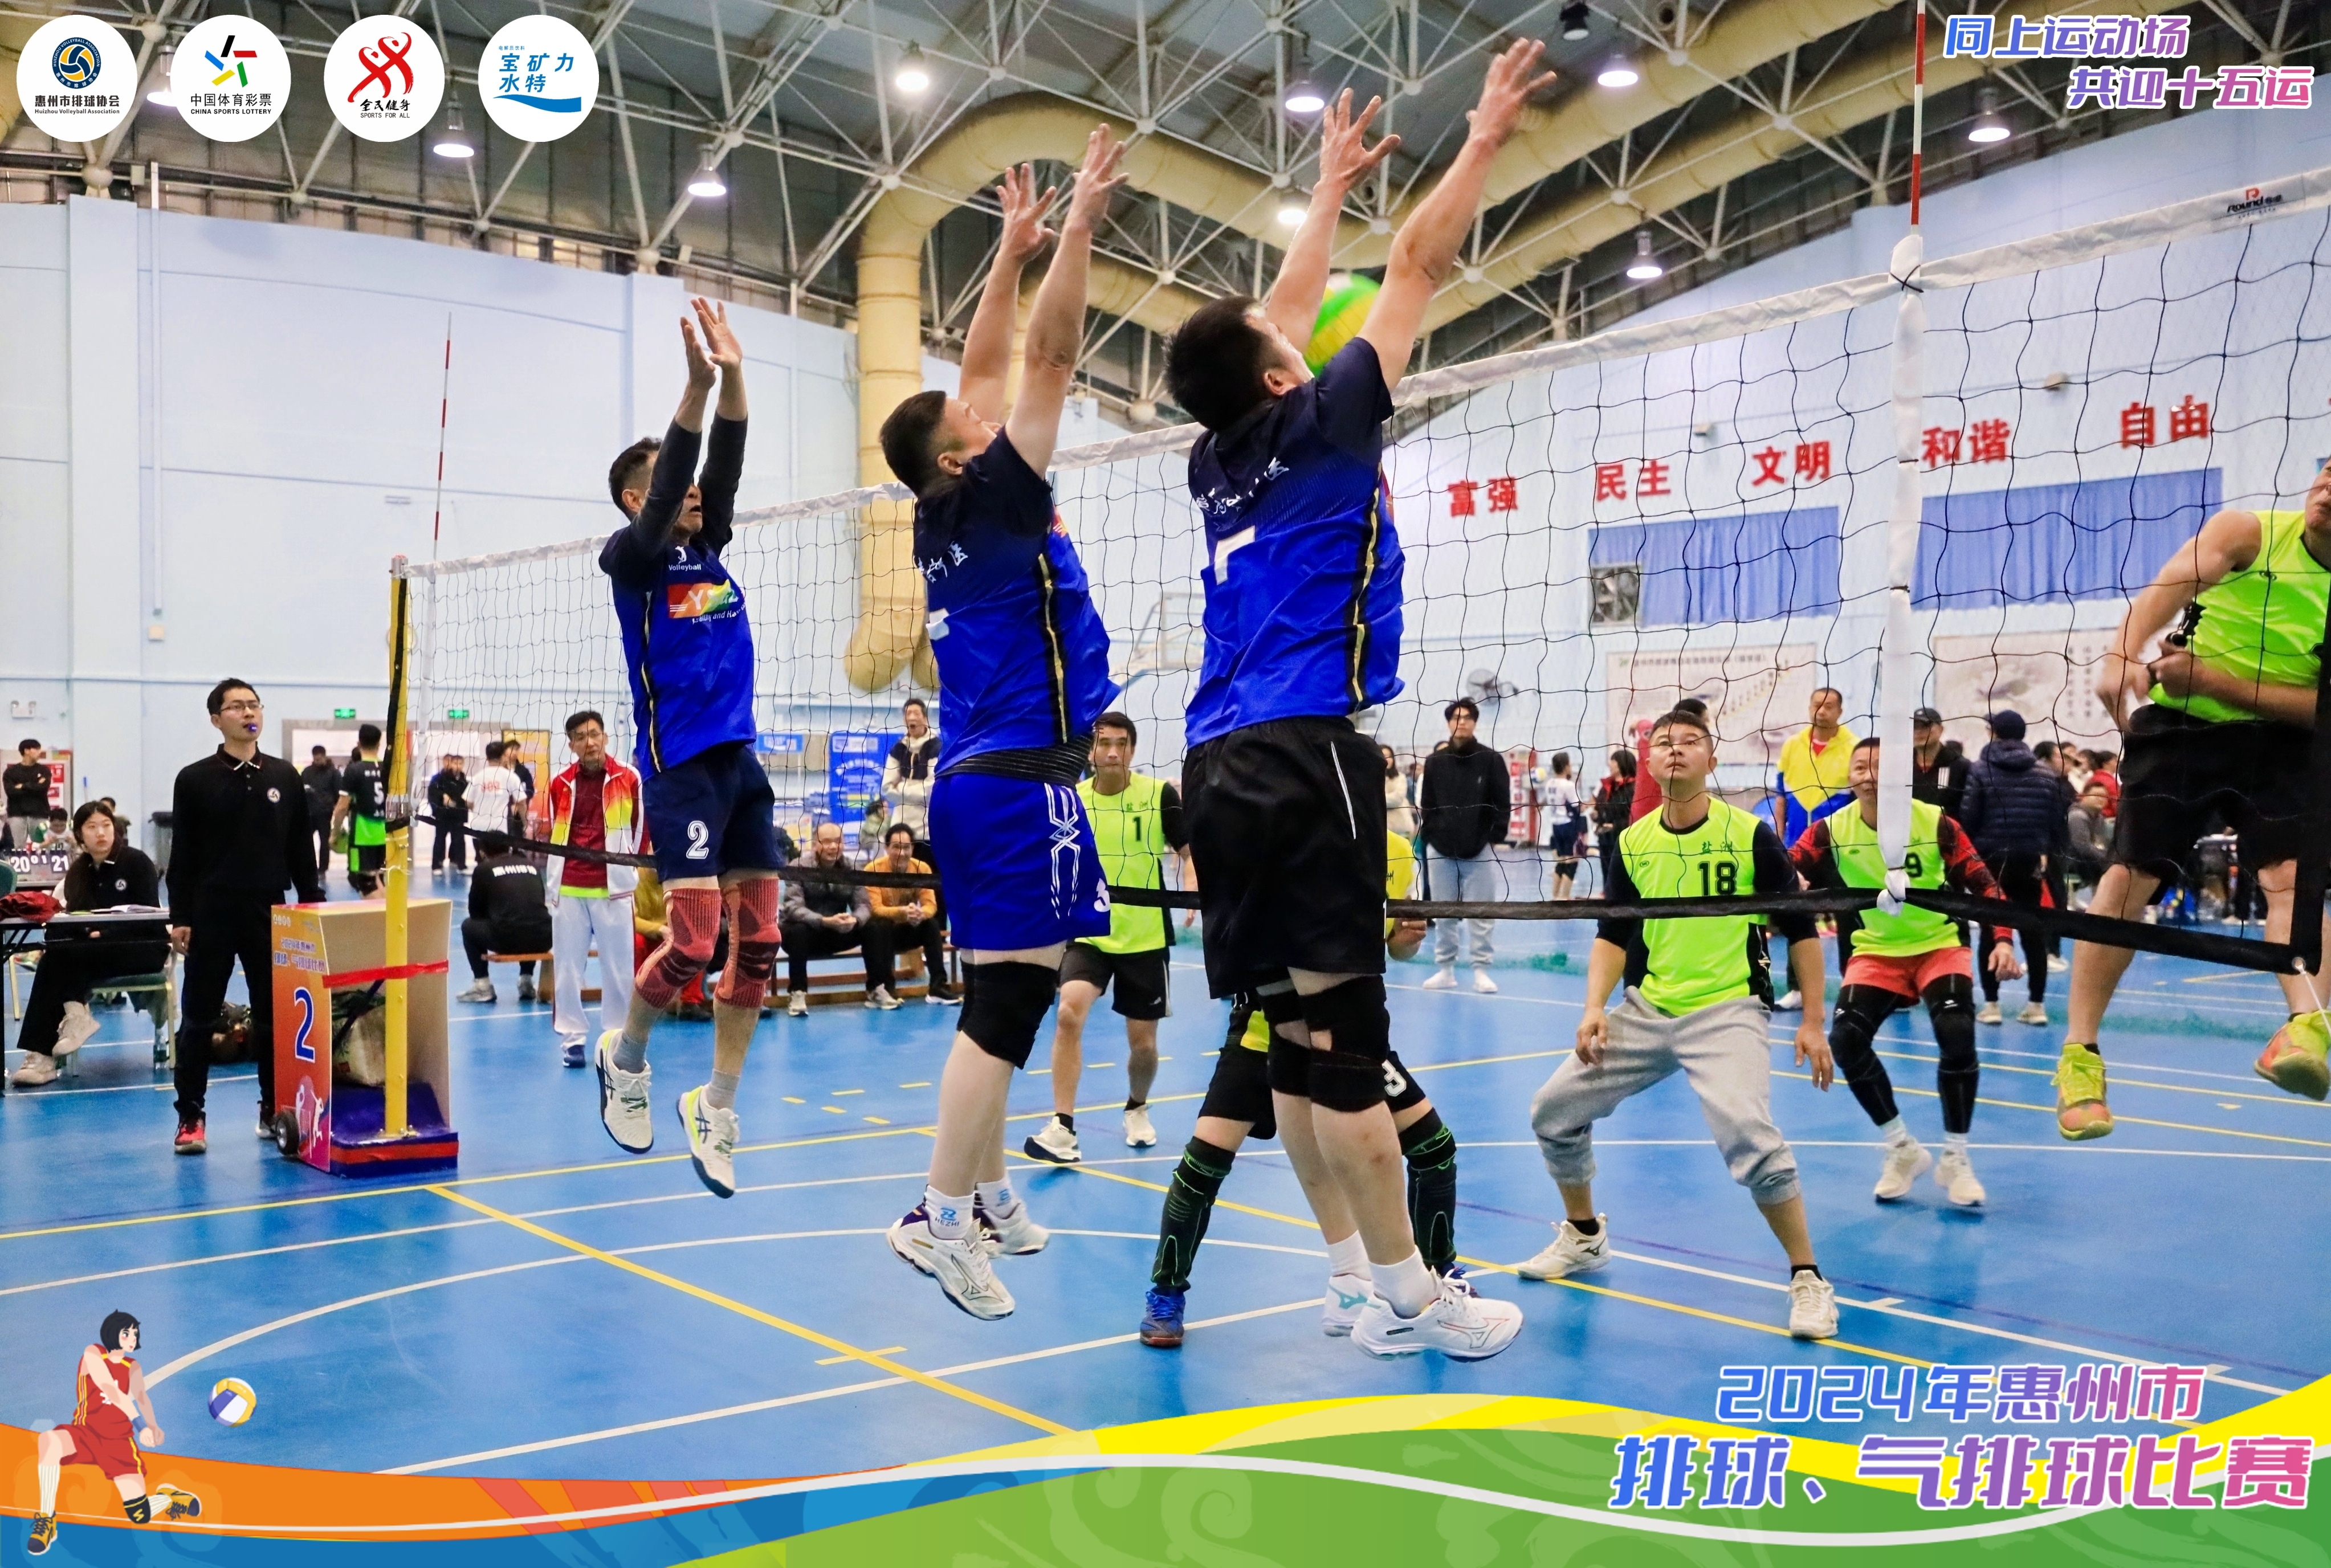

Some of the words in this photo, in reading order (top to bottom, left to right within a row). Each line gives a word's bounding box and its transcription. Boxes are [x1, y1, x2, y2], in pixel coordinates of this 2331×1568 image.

[2121, 395, 2208, 448] 自由
[1751, 440, 1831, 487] 文明
[1922, 419, 2010, 468] 和谐
[1448, 477, 1518, 517] 富强
[1596, 460, 1670, 502] 民主
[686, 820, 709, 859] 2
[1132, 816, 1142, 842] 1
[10, 856, 30, 872] 20
[51, 856, 69, 872] 21
[1698, 861, 1737, 897] 18
[294, 986, 315, 1064] 2
